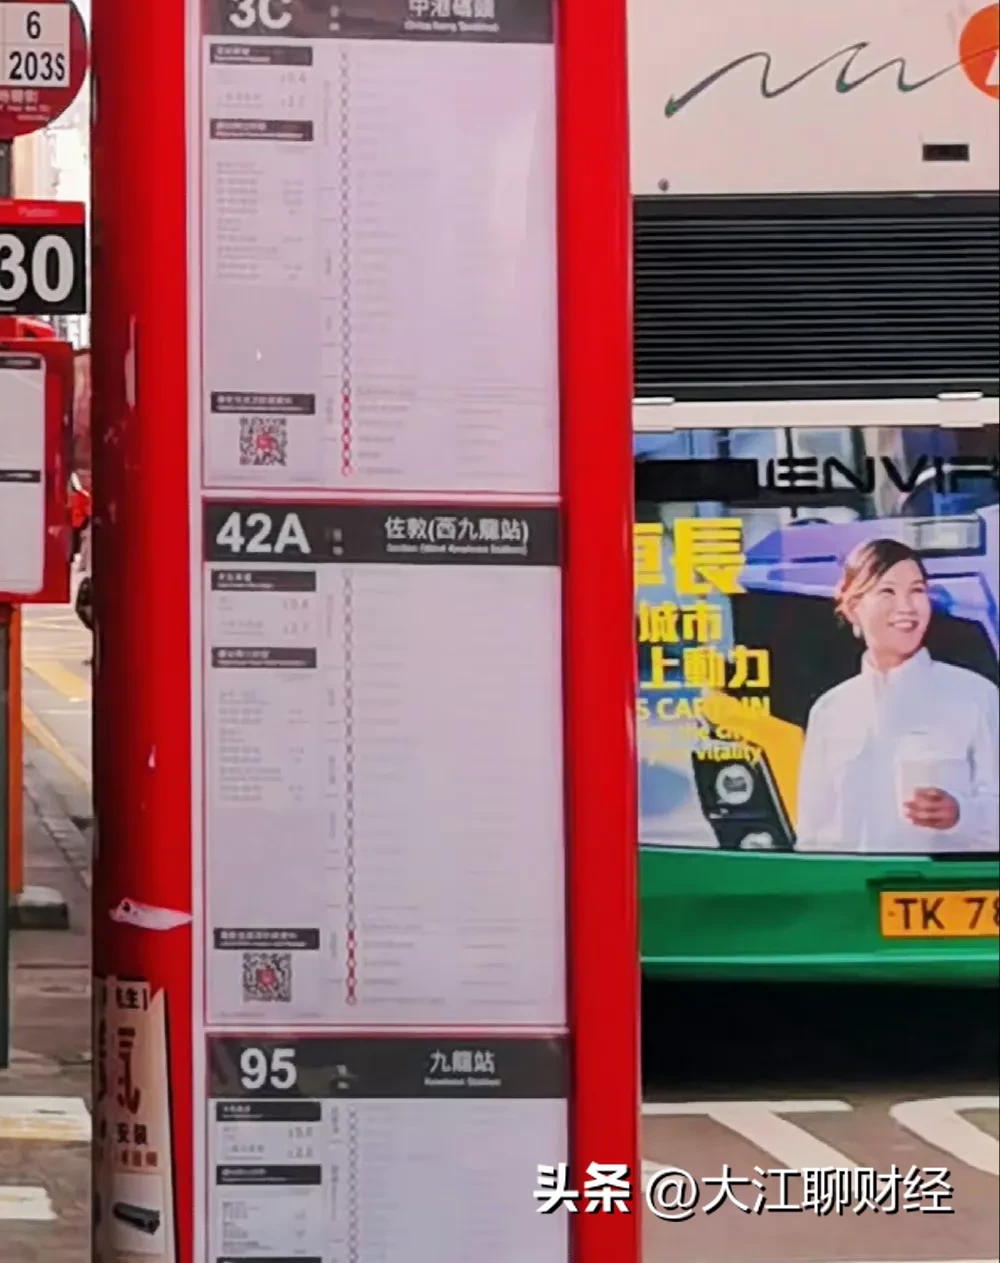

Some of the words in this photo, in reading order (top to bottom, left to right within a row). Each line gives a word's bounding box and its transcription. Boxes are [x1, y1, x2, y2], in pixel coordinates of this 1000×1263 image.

[26, 11, 41, 39] 6
[9, 51, 66, 81] 203S
[215, 511, 312, 554] 42A
[894, 897, 946, 930] TK
[964, 896, 998, 930] 7
[240, 1048, 297, 1089] 95
